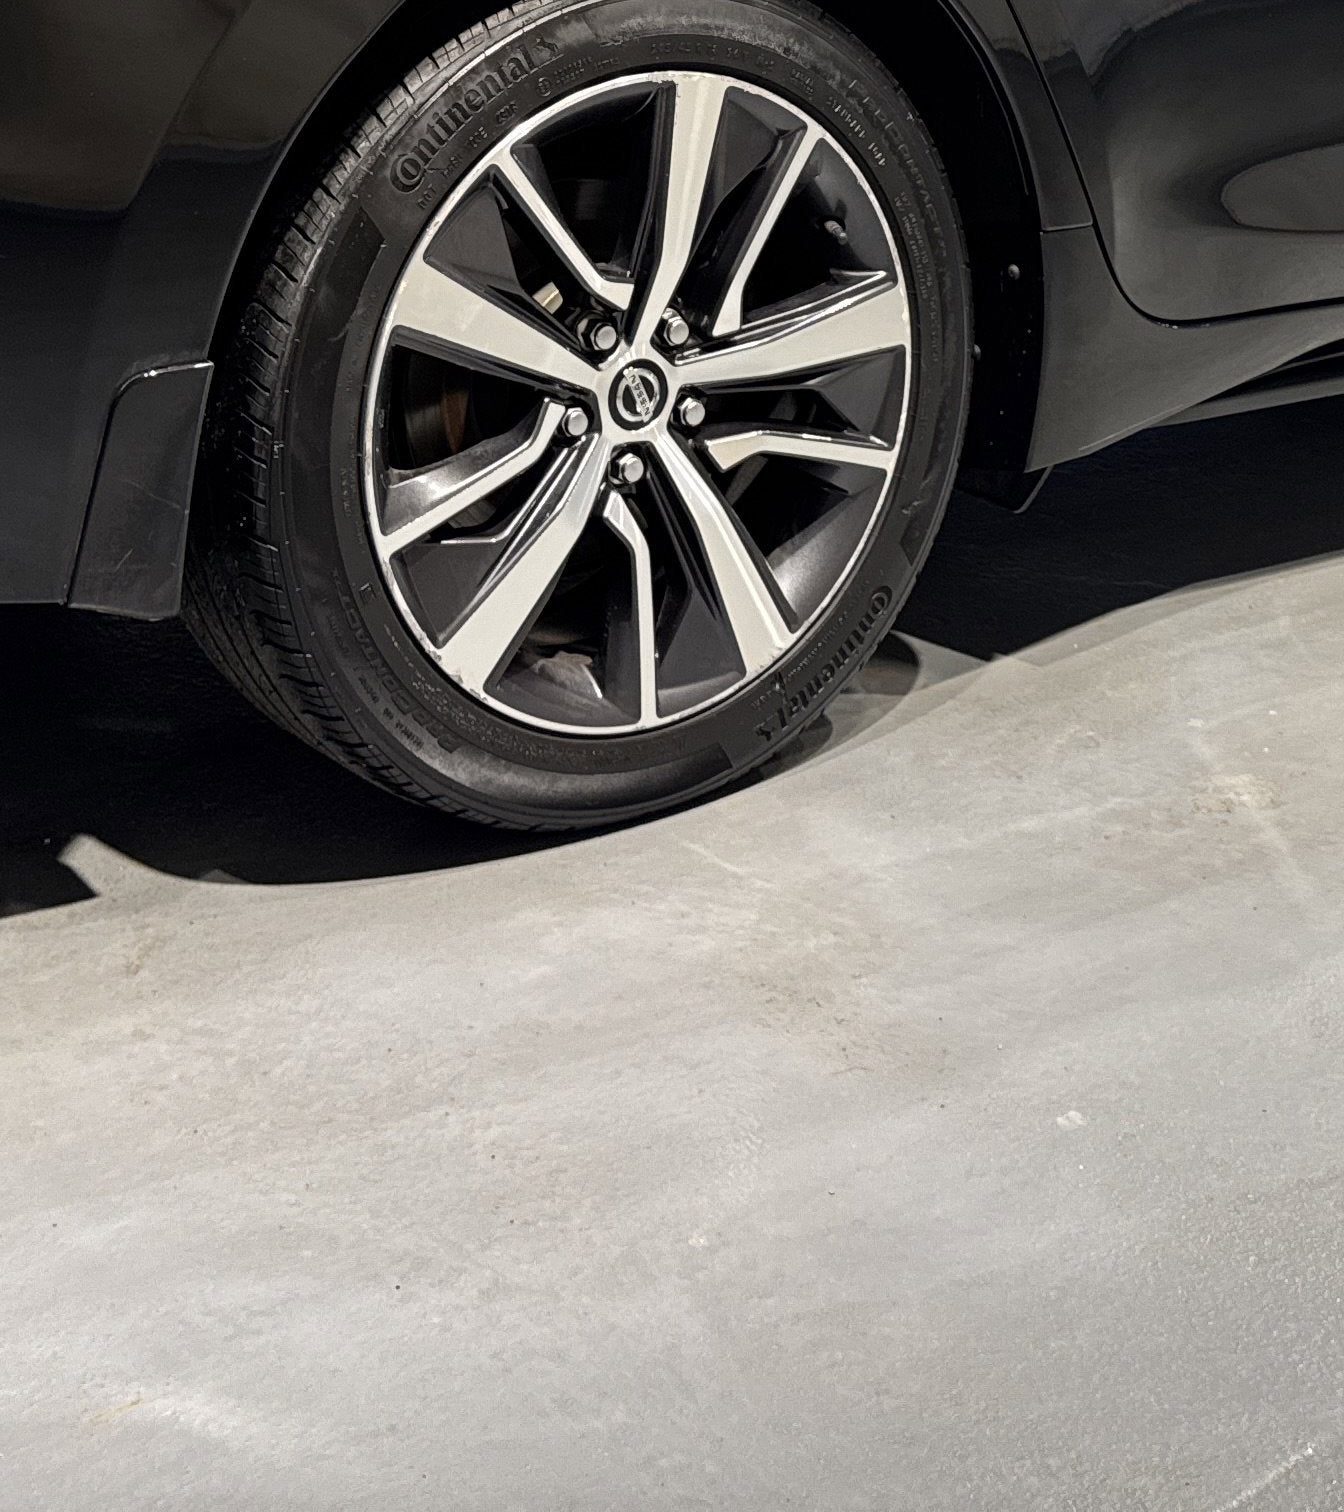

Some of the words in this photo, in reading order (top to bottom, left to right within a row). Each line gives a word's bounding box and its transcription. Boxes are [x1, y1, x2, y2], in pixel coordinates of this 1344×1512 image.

[390, 43, 537, 192] Continental
[628, 373, 651, 417] NISSAN
[777, 586, 893, 730] Continental
